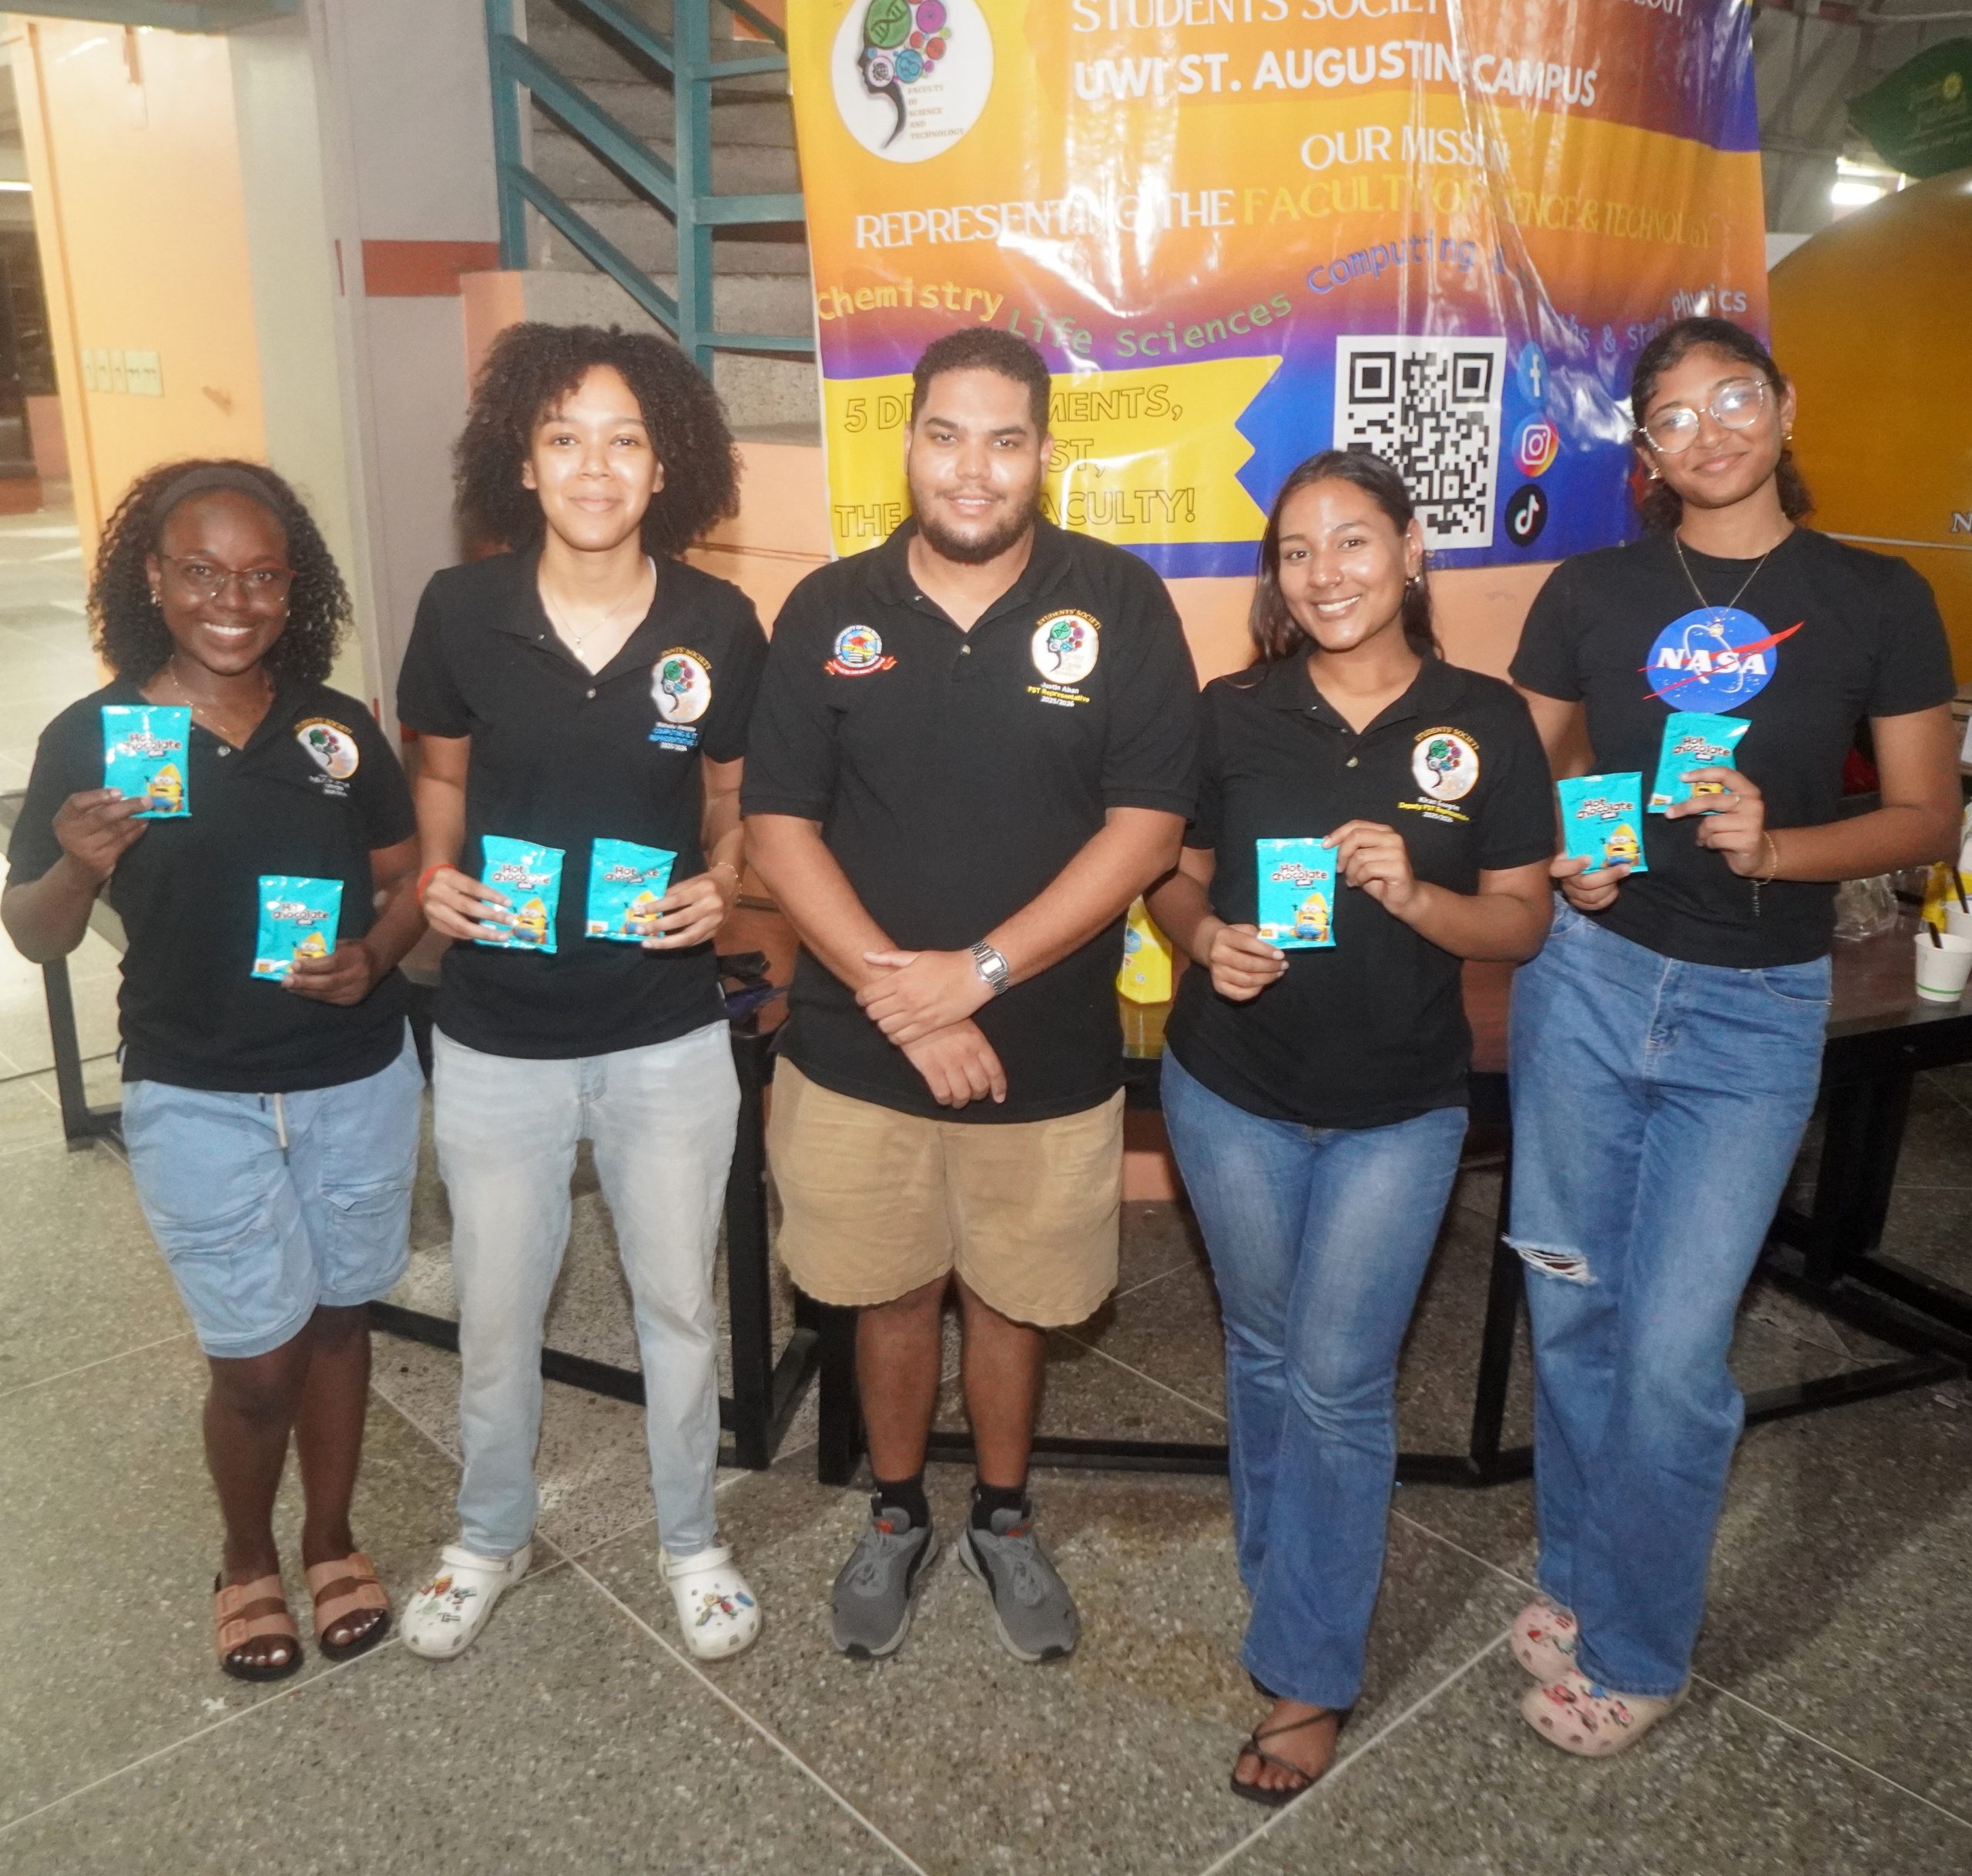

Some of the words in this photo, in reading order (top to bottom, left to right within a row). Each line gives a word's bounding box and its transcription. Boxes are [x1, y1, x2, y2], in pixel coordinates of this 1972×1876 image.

[1075, 58, 1162, 101] UWI
[1179, 54, 1243, 94] ST.
[1472, 53, 1598, 107] CAMPUS
[1302, 125, 1392, 171] OUR
[856, 195, 1140, 250] REPRESENTIG
[1157, 189, 1234, 229] THE
[1579, 198, 1600, 233] &
[844, 397, 868, 433] 5
[834, 502, 901, 538] THE
[1040, 487, 1196, 528] ACULTY!
[1656, 647, 1768, 675] NASA
[1027, 685, 1041, 694] FST
